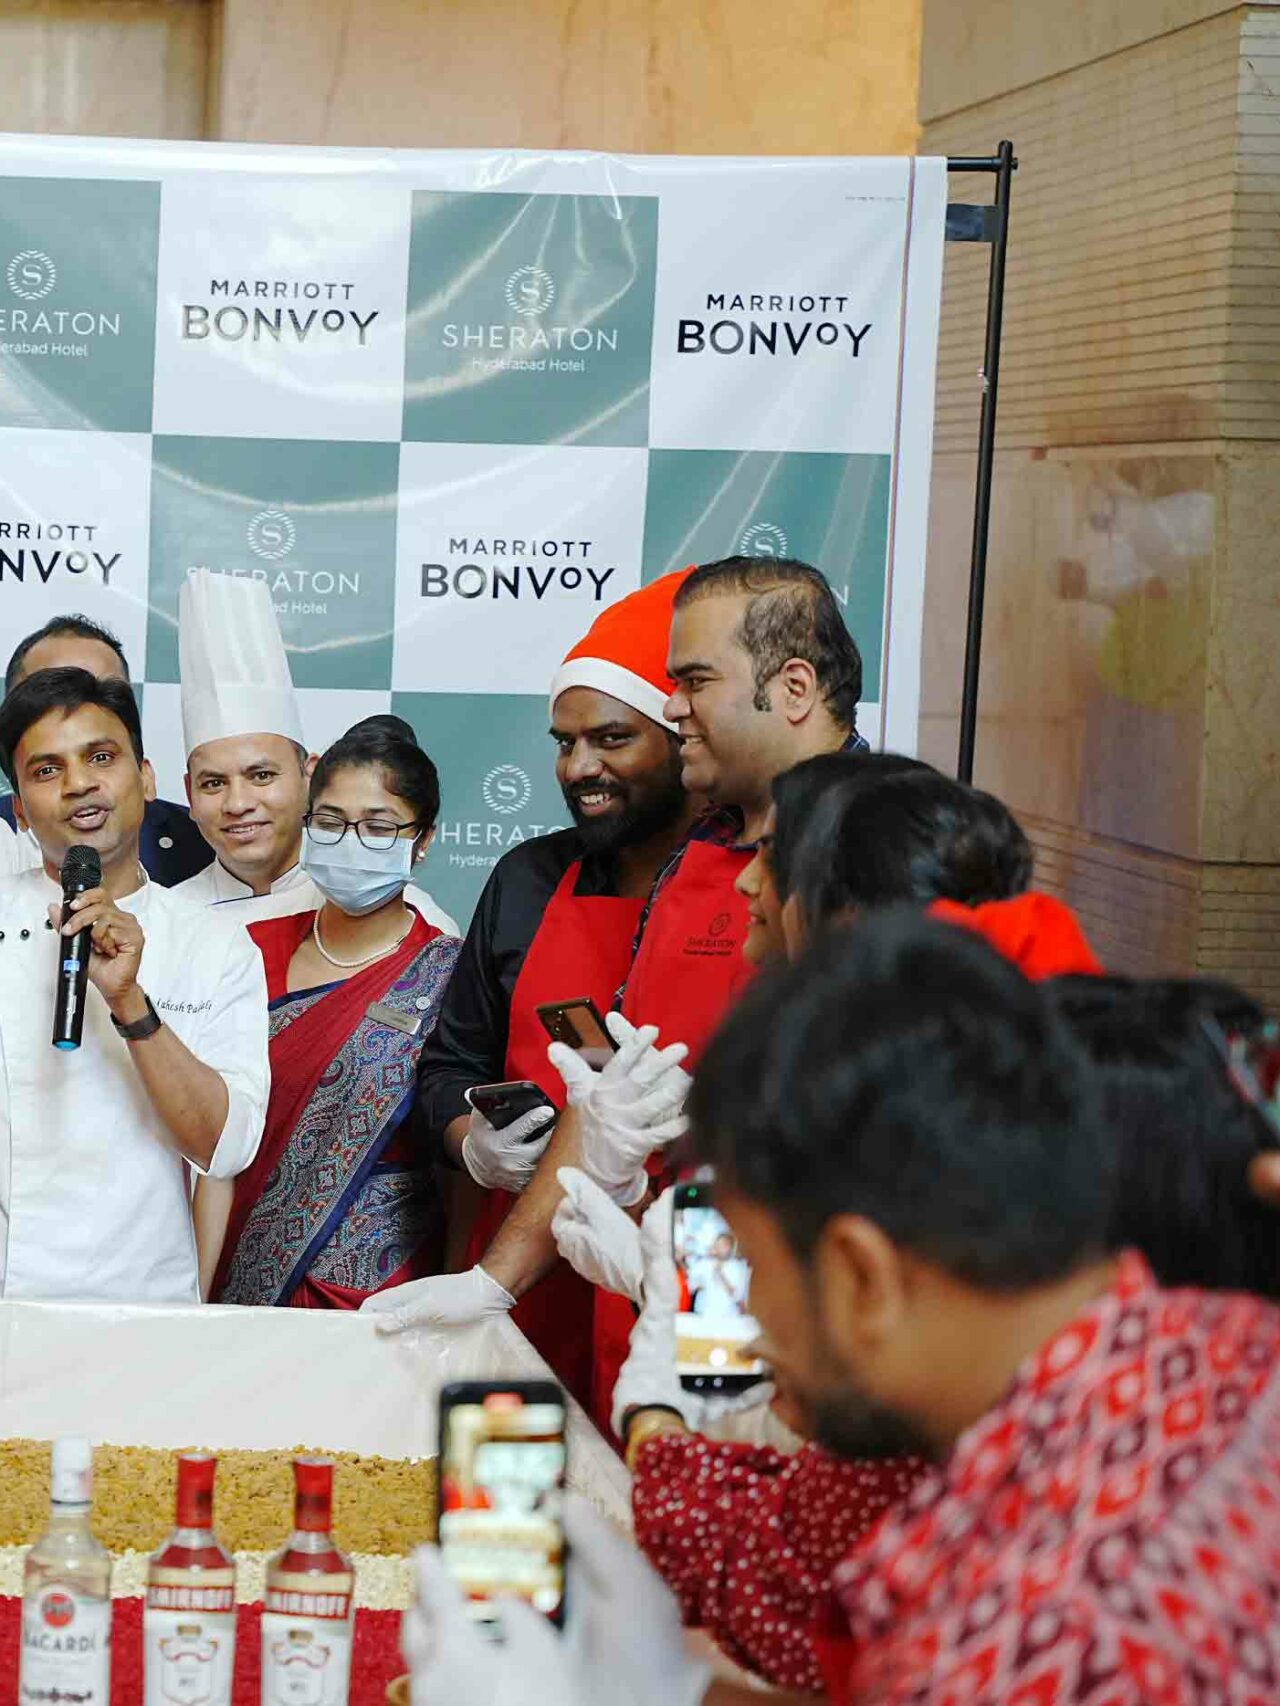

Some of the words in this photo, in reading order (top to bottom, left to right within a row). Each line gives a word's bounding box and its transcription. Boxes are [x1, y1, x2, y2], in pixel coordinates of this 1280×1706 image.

[211, 279, 355, 301] MARRIOTT
[706, 294, 849, 314] MARRIOTT
[442, 324, 618, 352] SHERATON
[51, 343, 88, 357] Hotel
[472, 357, 546, 373] Hyderabad
[549, 359, 585, 373] Hotel
[449, 538, 592, 557] MARRIOTT
[291, 600, 328, 615] Hotel
[440, 822, 566, 846] HERAT
[449, 854, 499, 869] Hydera
